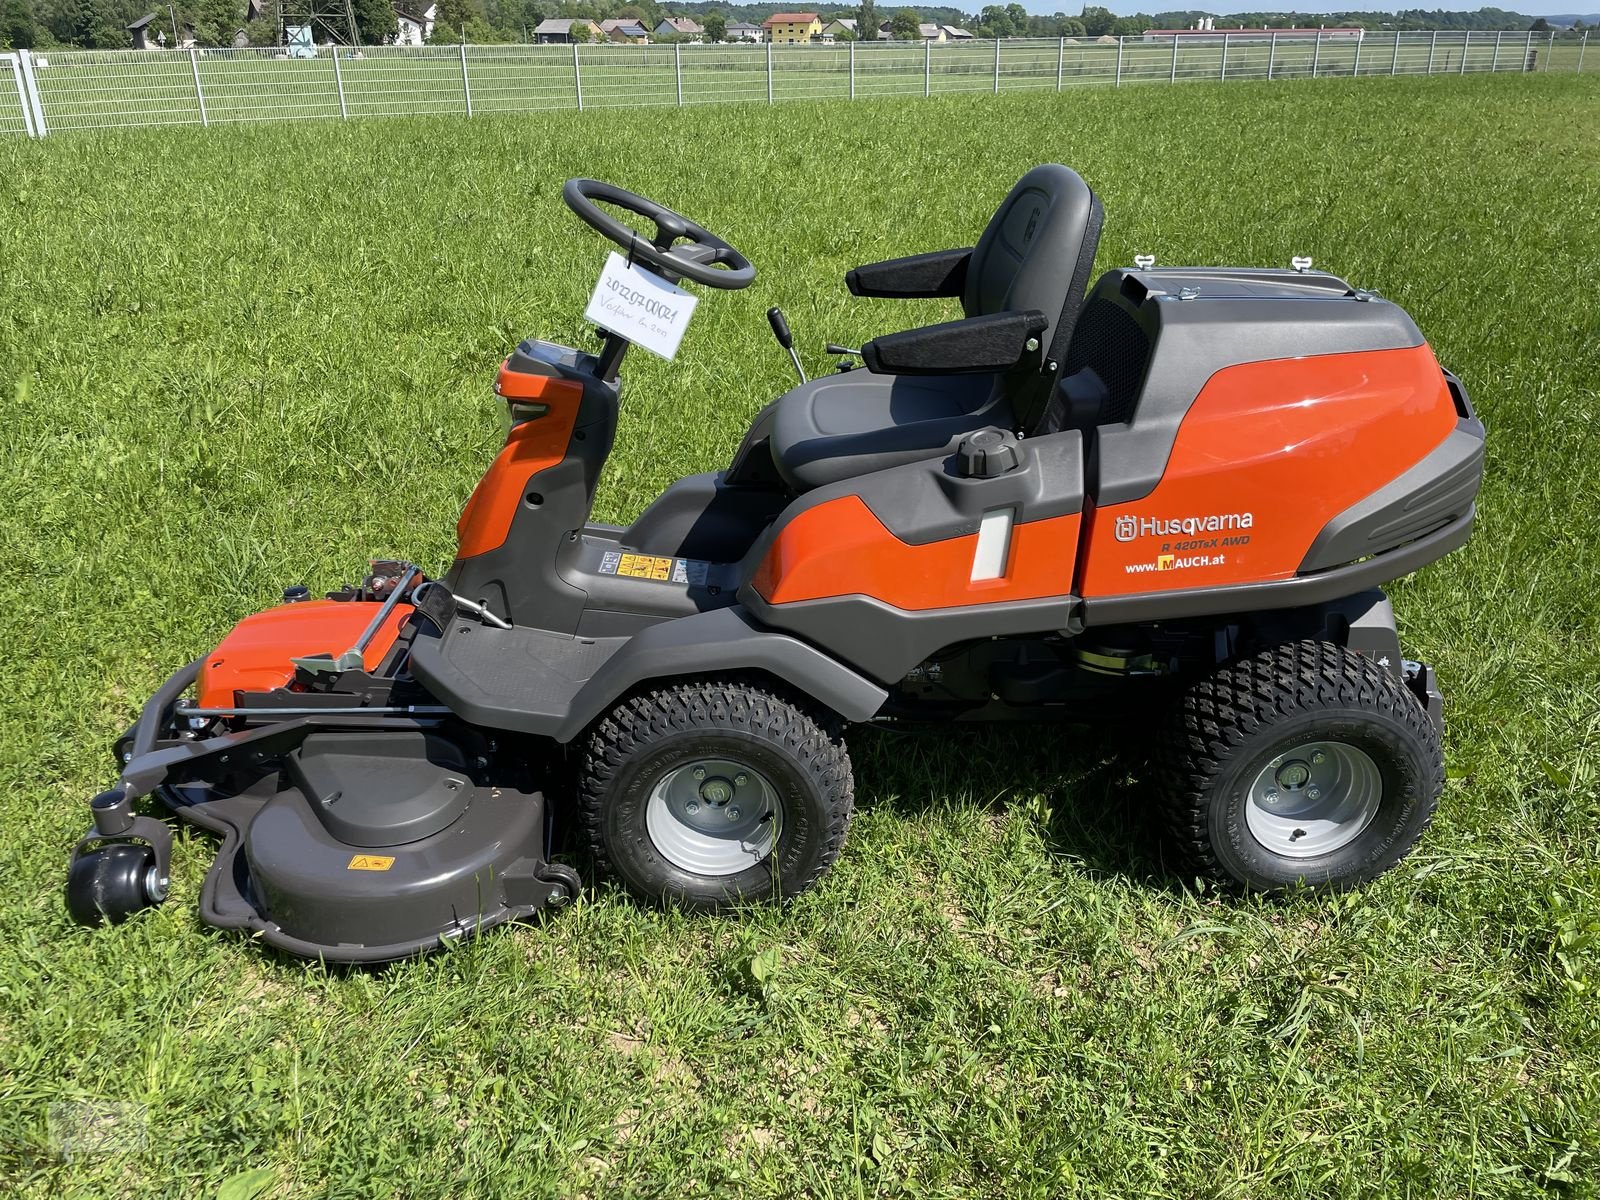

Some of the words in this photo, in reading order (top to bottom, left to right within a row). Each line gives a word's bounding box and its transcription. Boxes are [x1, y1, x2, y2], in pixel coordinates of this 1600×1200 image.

[1139, 512, 1253, 537] Husqvarna
[1161, 543, 1171, 552] R
[1221, 535, 1250, 547] AWD
[1125, 554, 1225, 573] www.MAUCH.at
